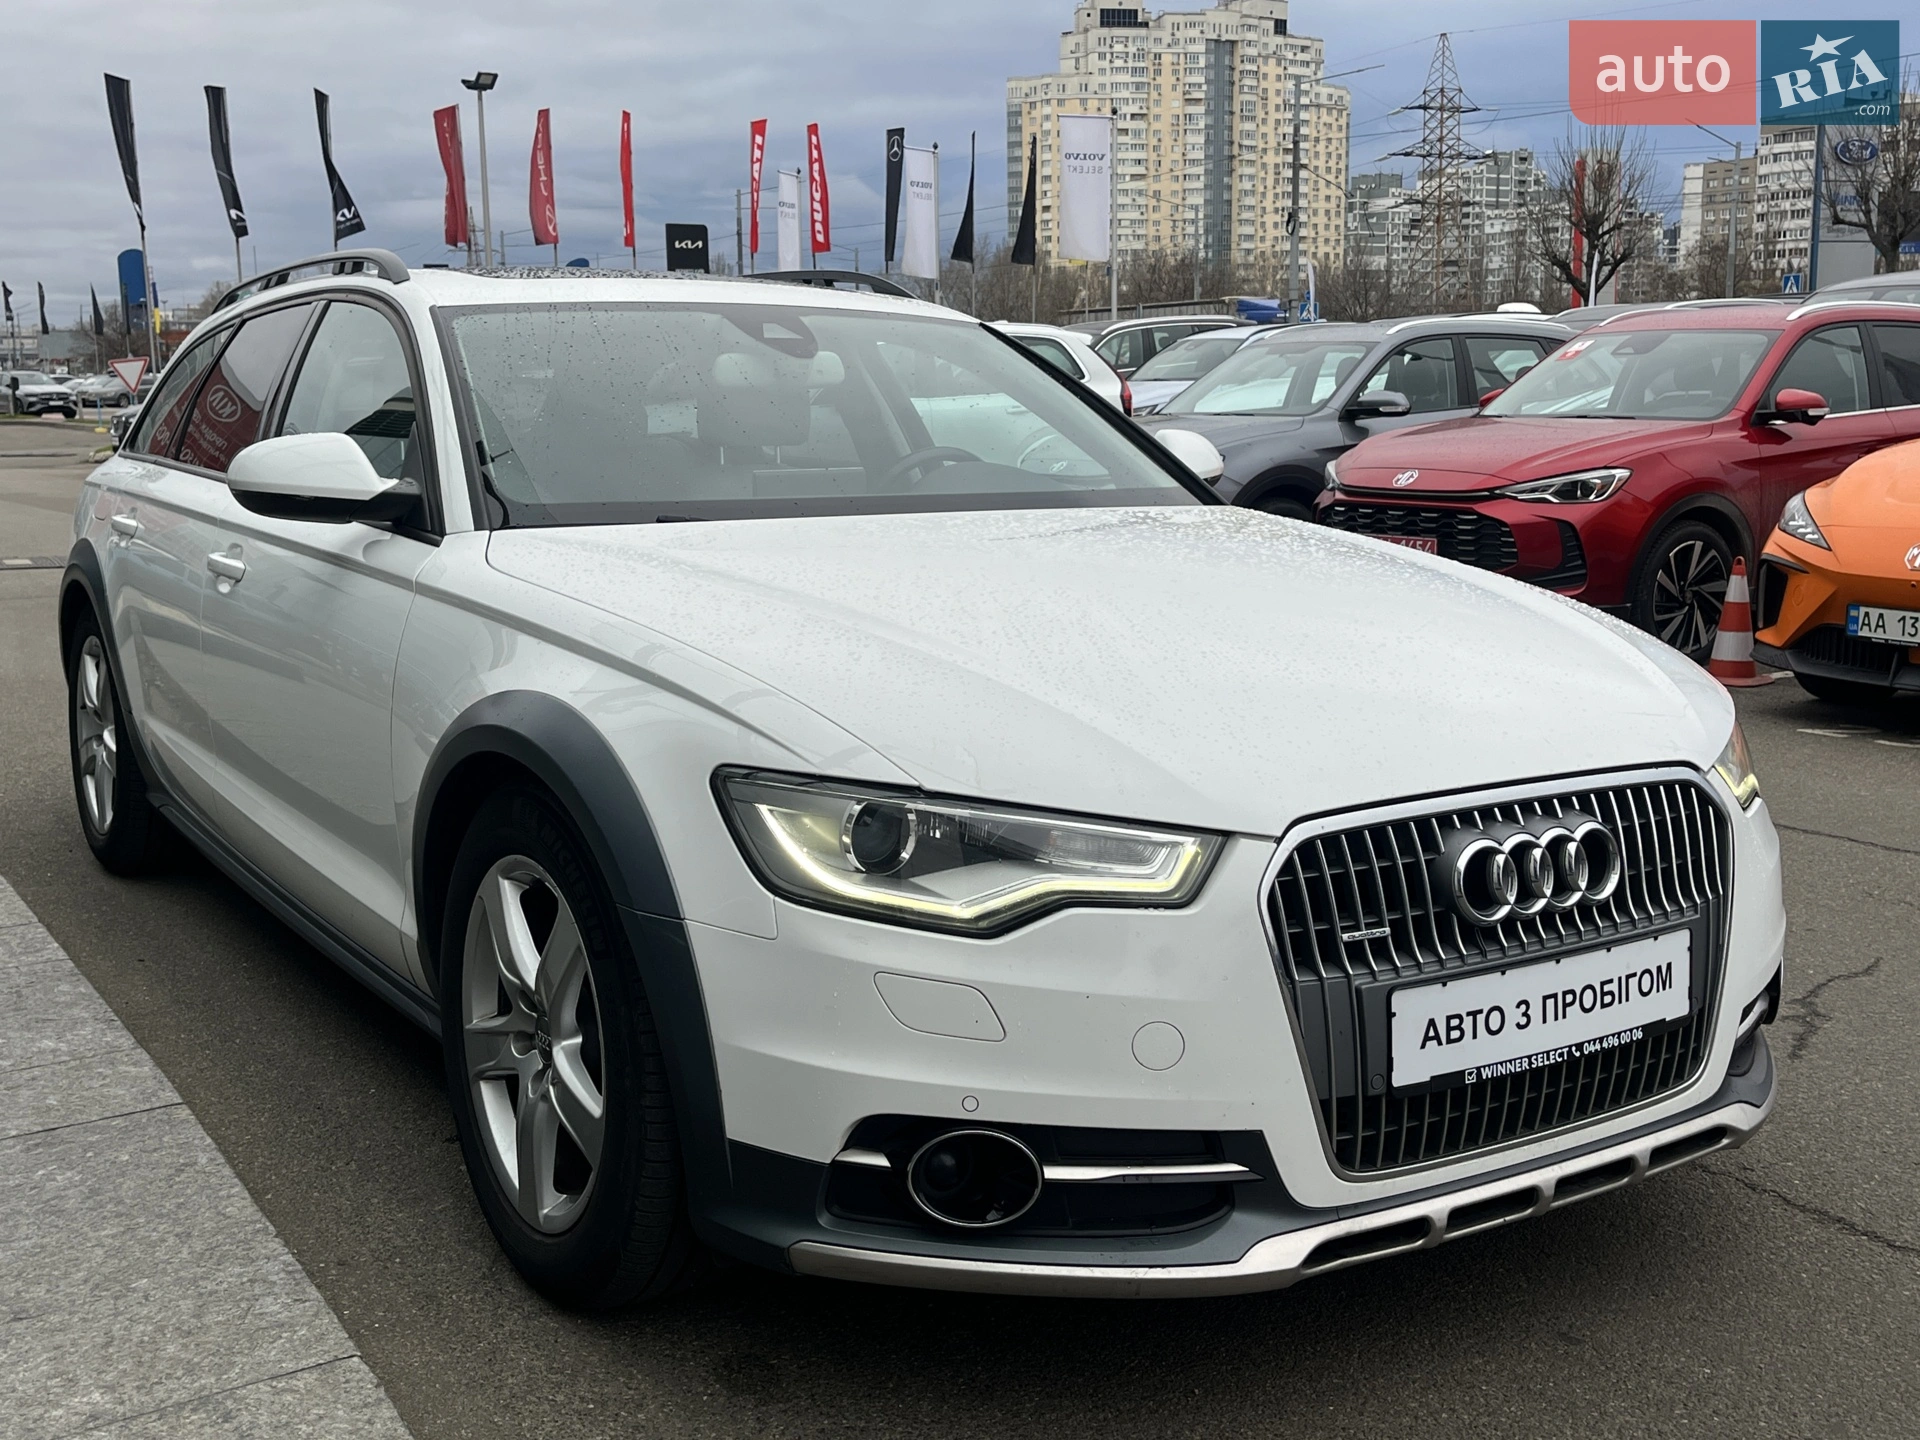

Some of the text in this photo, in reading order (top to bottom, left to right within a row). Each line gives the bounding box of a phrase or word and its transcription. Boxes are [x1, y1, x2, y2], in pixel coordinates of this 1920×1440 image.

[811, 134, 825, 243] DUCATI
[1860, 611, 1887, 634] AA
[1347, 930, 1387, 940] quattro
[1419, 1005, 1506, 1050] АВТО
[1541, 961, 1673, 1025] ПРОБІГОМ
[1480, 1027, 1643, 1080] WINNER SELECT 044 496 00 06
